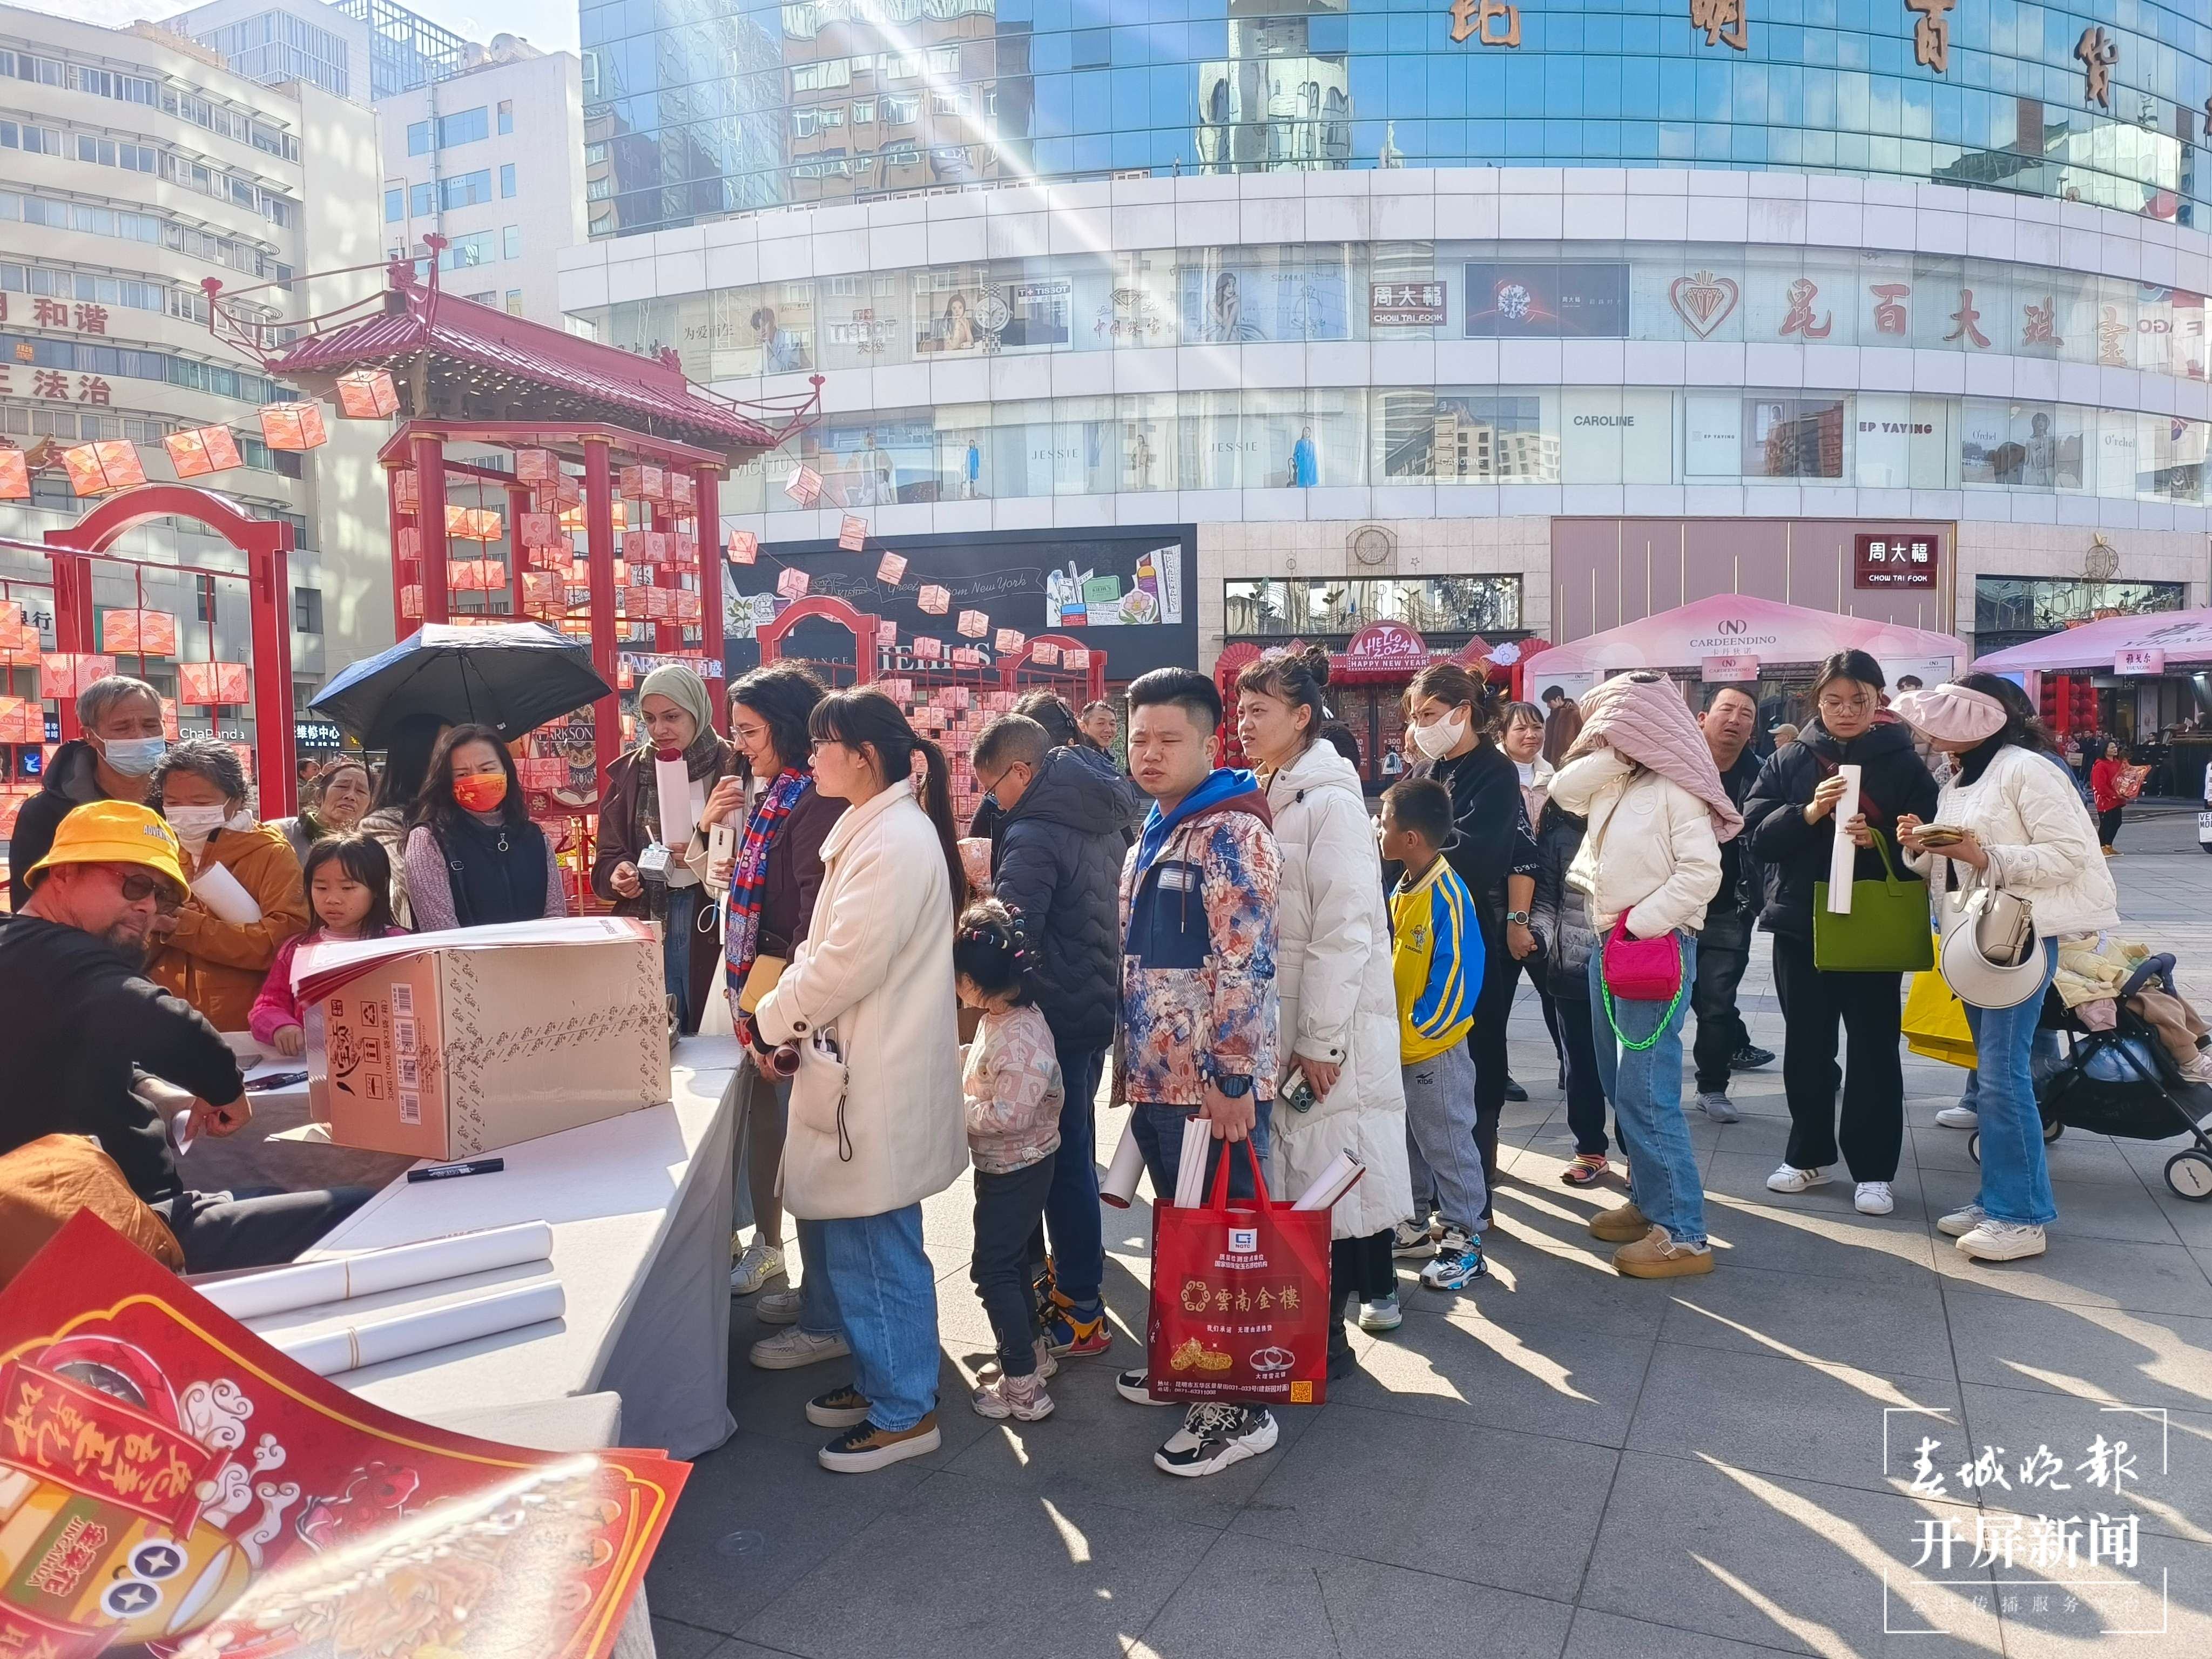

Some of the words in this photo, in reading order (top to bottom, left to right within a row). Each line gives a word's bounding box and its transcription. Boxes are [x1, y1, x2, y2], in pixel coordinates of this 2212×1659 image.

[1035, 286, 1068, 295] TISSOT
[1374, 286, 1441, 307] 周大福
[33, 299, 108, 334] 和谐
[1374, 314, 1398, 322] CHOW
[1401, 314, 1416, 322] TAI
[1419, 314, 1442, 322] FOOK
[33, 369, 111, 405] 法治
[1574, 416, 1634, 427] CAROLINE
[1859, 422, 1876, 433] EP
[1882, 422, 1932, 435] YAYING
[1210, 442, 1257, 453] JESSIE
[1032, 448, 1078, 460] JESSIE
[1441, 458, 1484, 467] CAROLINE
[1868, 542, 1928, 563] 周大福
[972, 582, 995, 594] New
[997, 574, 1027, 589] York
[1907, 575, 1928, 583] FOOK
[1365, 633, 1401, 656] HELLO
[1690, 636, 1776, 647] CARDEENDINO
[1373, 640, 1410, 657] 2024
[2126, 653, 2151, 666] 雅戈尔
[1417, 1076, 1433, 1084] KIDS
